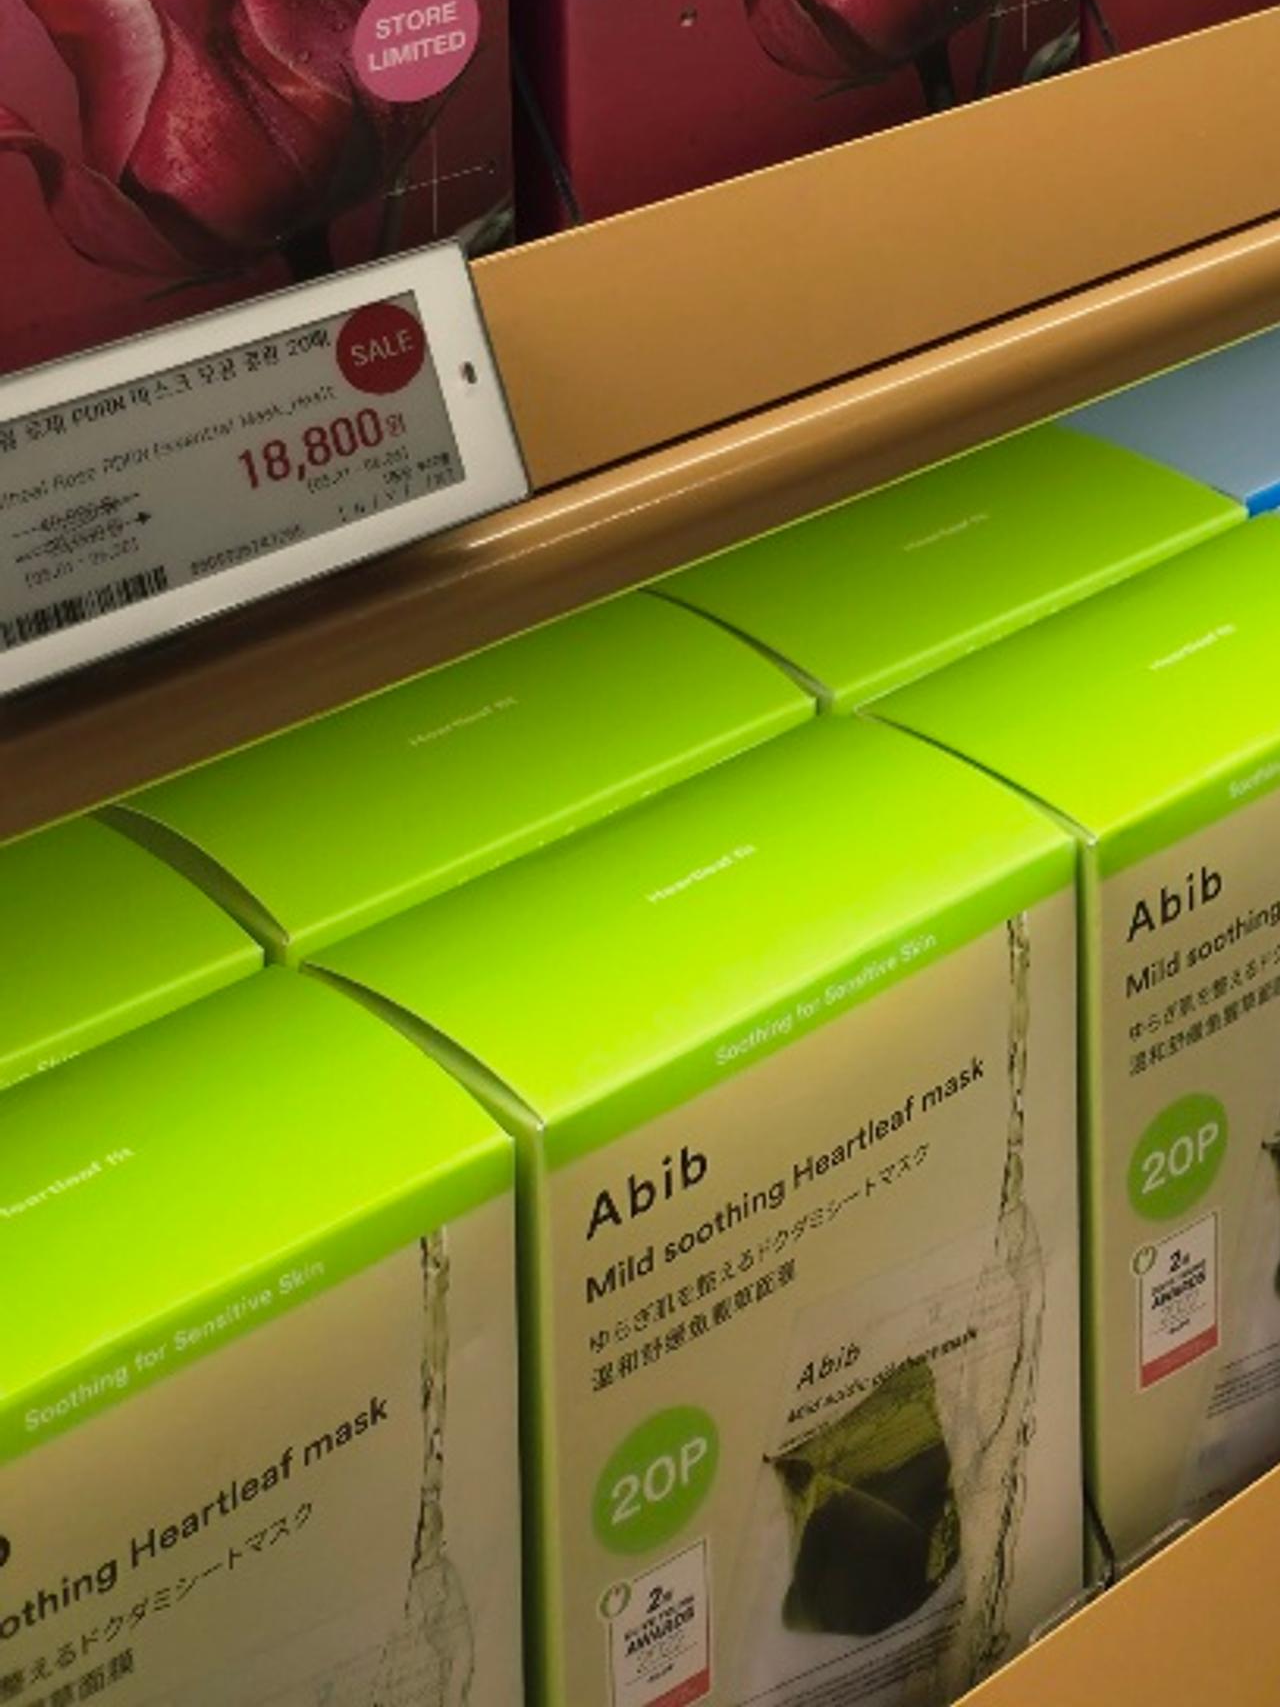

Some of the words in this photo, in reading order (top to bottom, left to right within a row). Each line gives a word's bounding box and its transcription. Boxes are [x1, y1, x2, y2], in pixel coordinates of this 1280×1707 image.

[367, 29, 468, 75] LIMITED
[375, 0, 459, 41] STORE
[350, 328, 415, 369] SALE
[1125, 864, 1224, 944] Abib
[715, 1014, 794, 1066] Soothing
[900, 931, 938, 963] Skin
[1125, 951, 1181, 1000] Mild
[583, 1245, 655, 1306] Mild
[662, 1181, 788, 1264] soothing
[792, 1094, 916, 1191] Heartleaf
[921, 1054, 986, 1116] mask
[584, 1144, 709, 1242] Abib
[1140, 1121, 1221, 1197] 20P
[24, 1363, 130, 1434] Soothing
[135, 1340, 168, 1376] for
[173, 1285, 273, 1353] Sensitive
[277, 1259, 326, 1295] Skin
[795, 1341, 862, 1392] Abib
[130, 1449, 295, 1570] Heartleaf
[303, 1395, 389, 1468] mask
[610, 1435, 709, 1524] 20P
